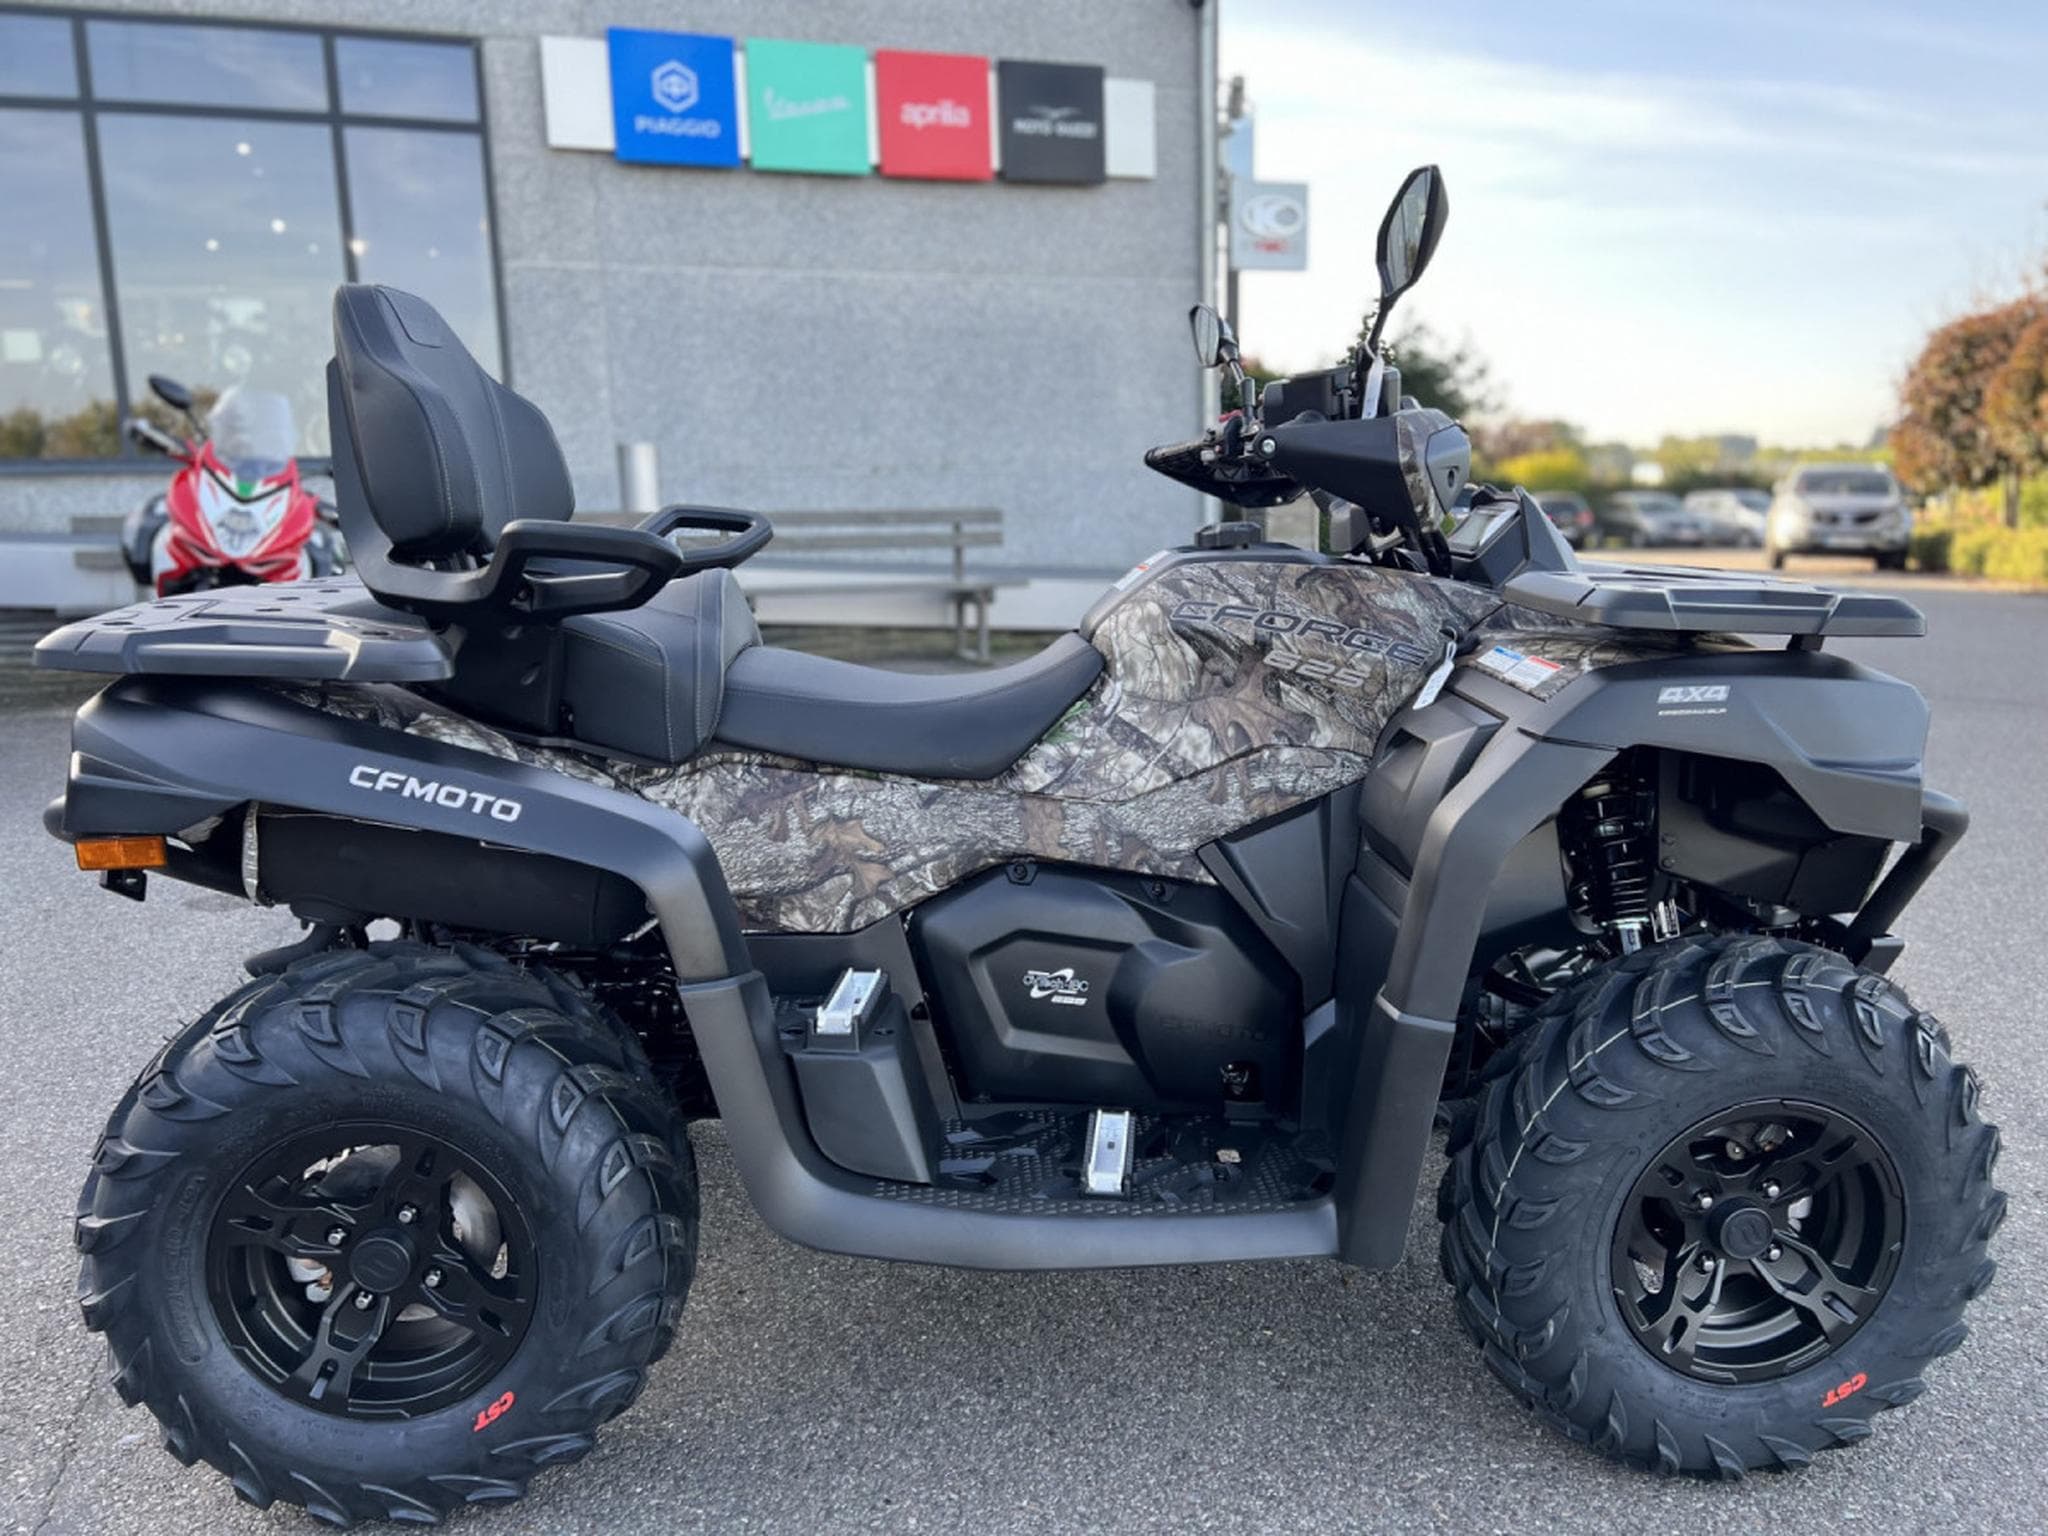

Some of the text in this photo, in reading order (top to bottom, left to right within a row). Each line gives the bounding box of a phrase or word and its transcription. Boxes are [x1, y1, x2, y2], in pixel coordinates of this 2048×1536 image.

[634, 115, 721, 138] PIAGGIO
[900, 99, 970, 128] aprilia
[1263, 650, 1372, 688] 625
[349, 765, 523, 822] CFMOTO
[1823, 1373, 1867, 1408] CST
[474, 1391, 514, 1432] CST
